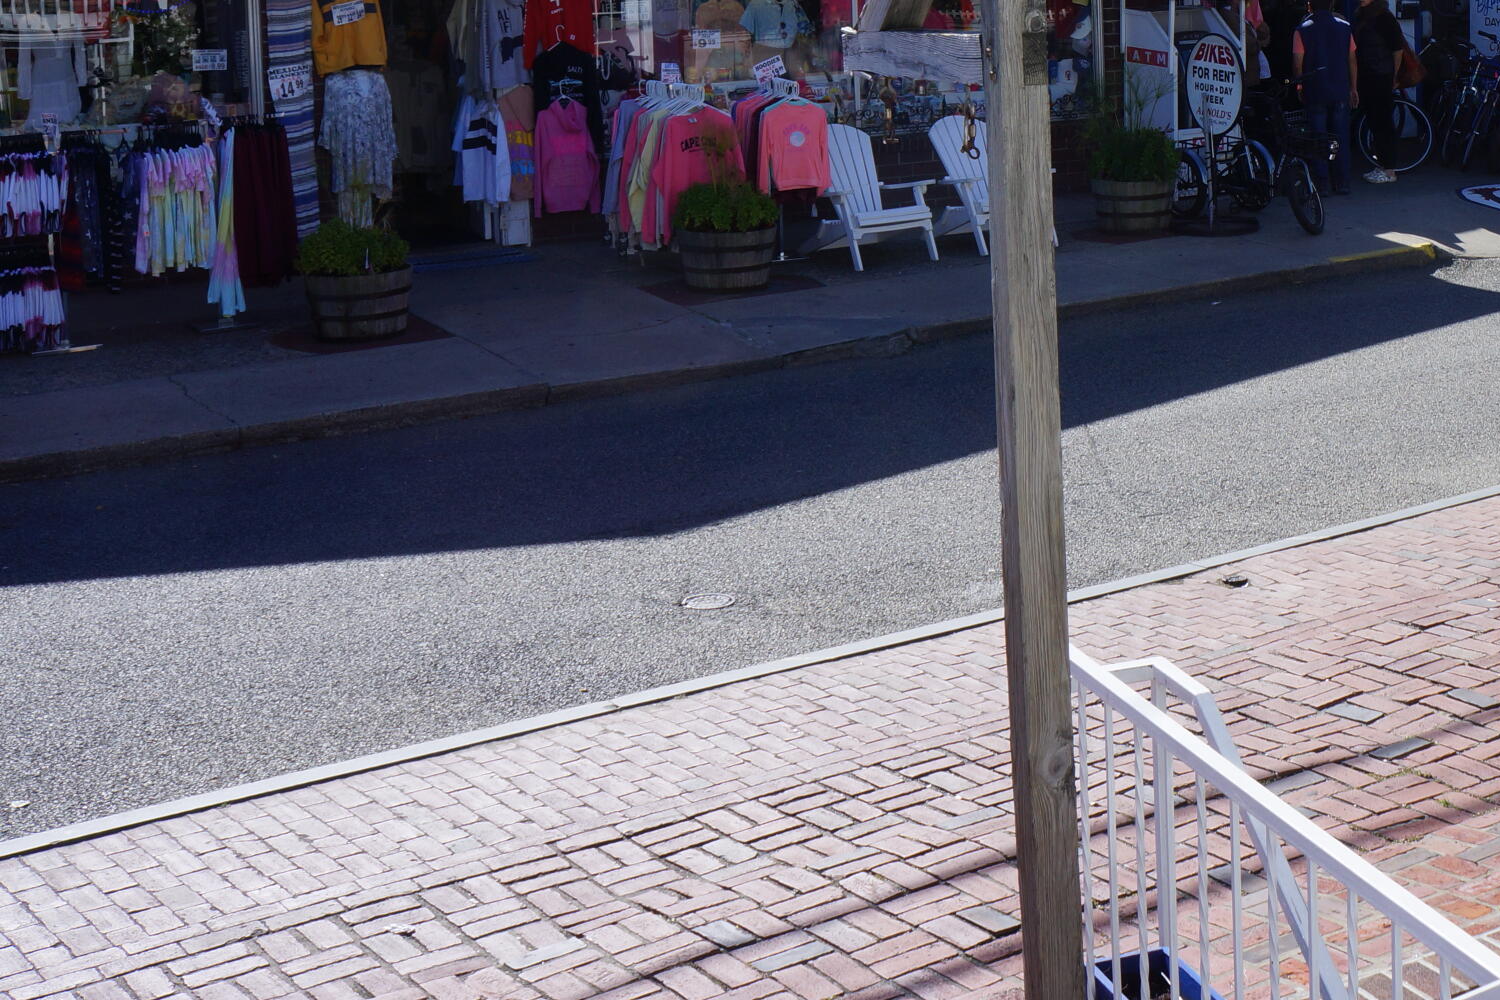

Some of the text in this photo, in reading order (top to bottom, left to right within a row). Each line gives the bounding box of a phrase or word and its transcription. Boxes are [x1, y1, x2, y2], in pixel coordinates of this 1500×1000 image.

[1484, 17, 1500, 26] DAY
[1132, 49, 1166, 65] ATM
[1193, 43, 1235, 67] BIKES
[1192, 65, 1235, 84] FOR RENT
[1194, 81, 1233, 96] HOUR DAY
